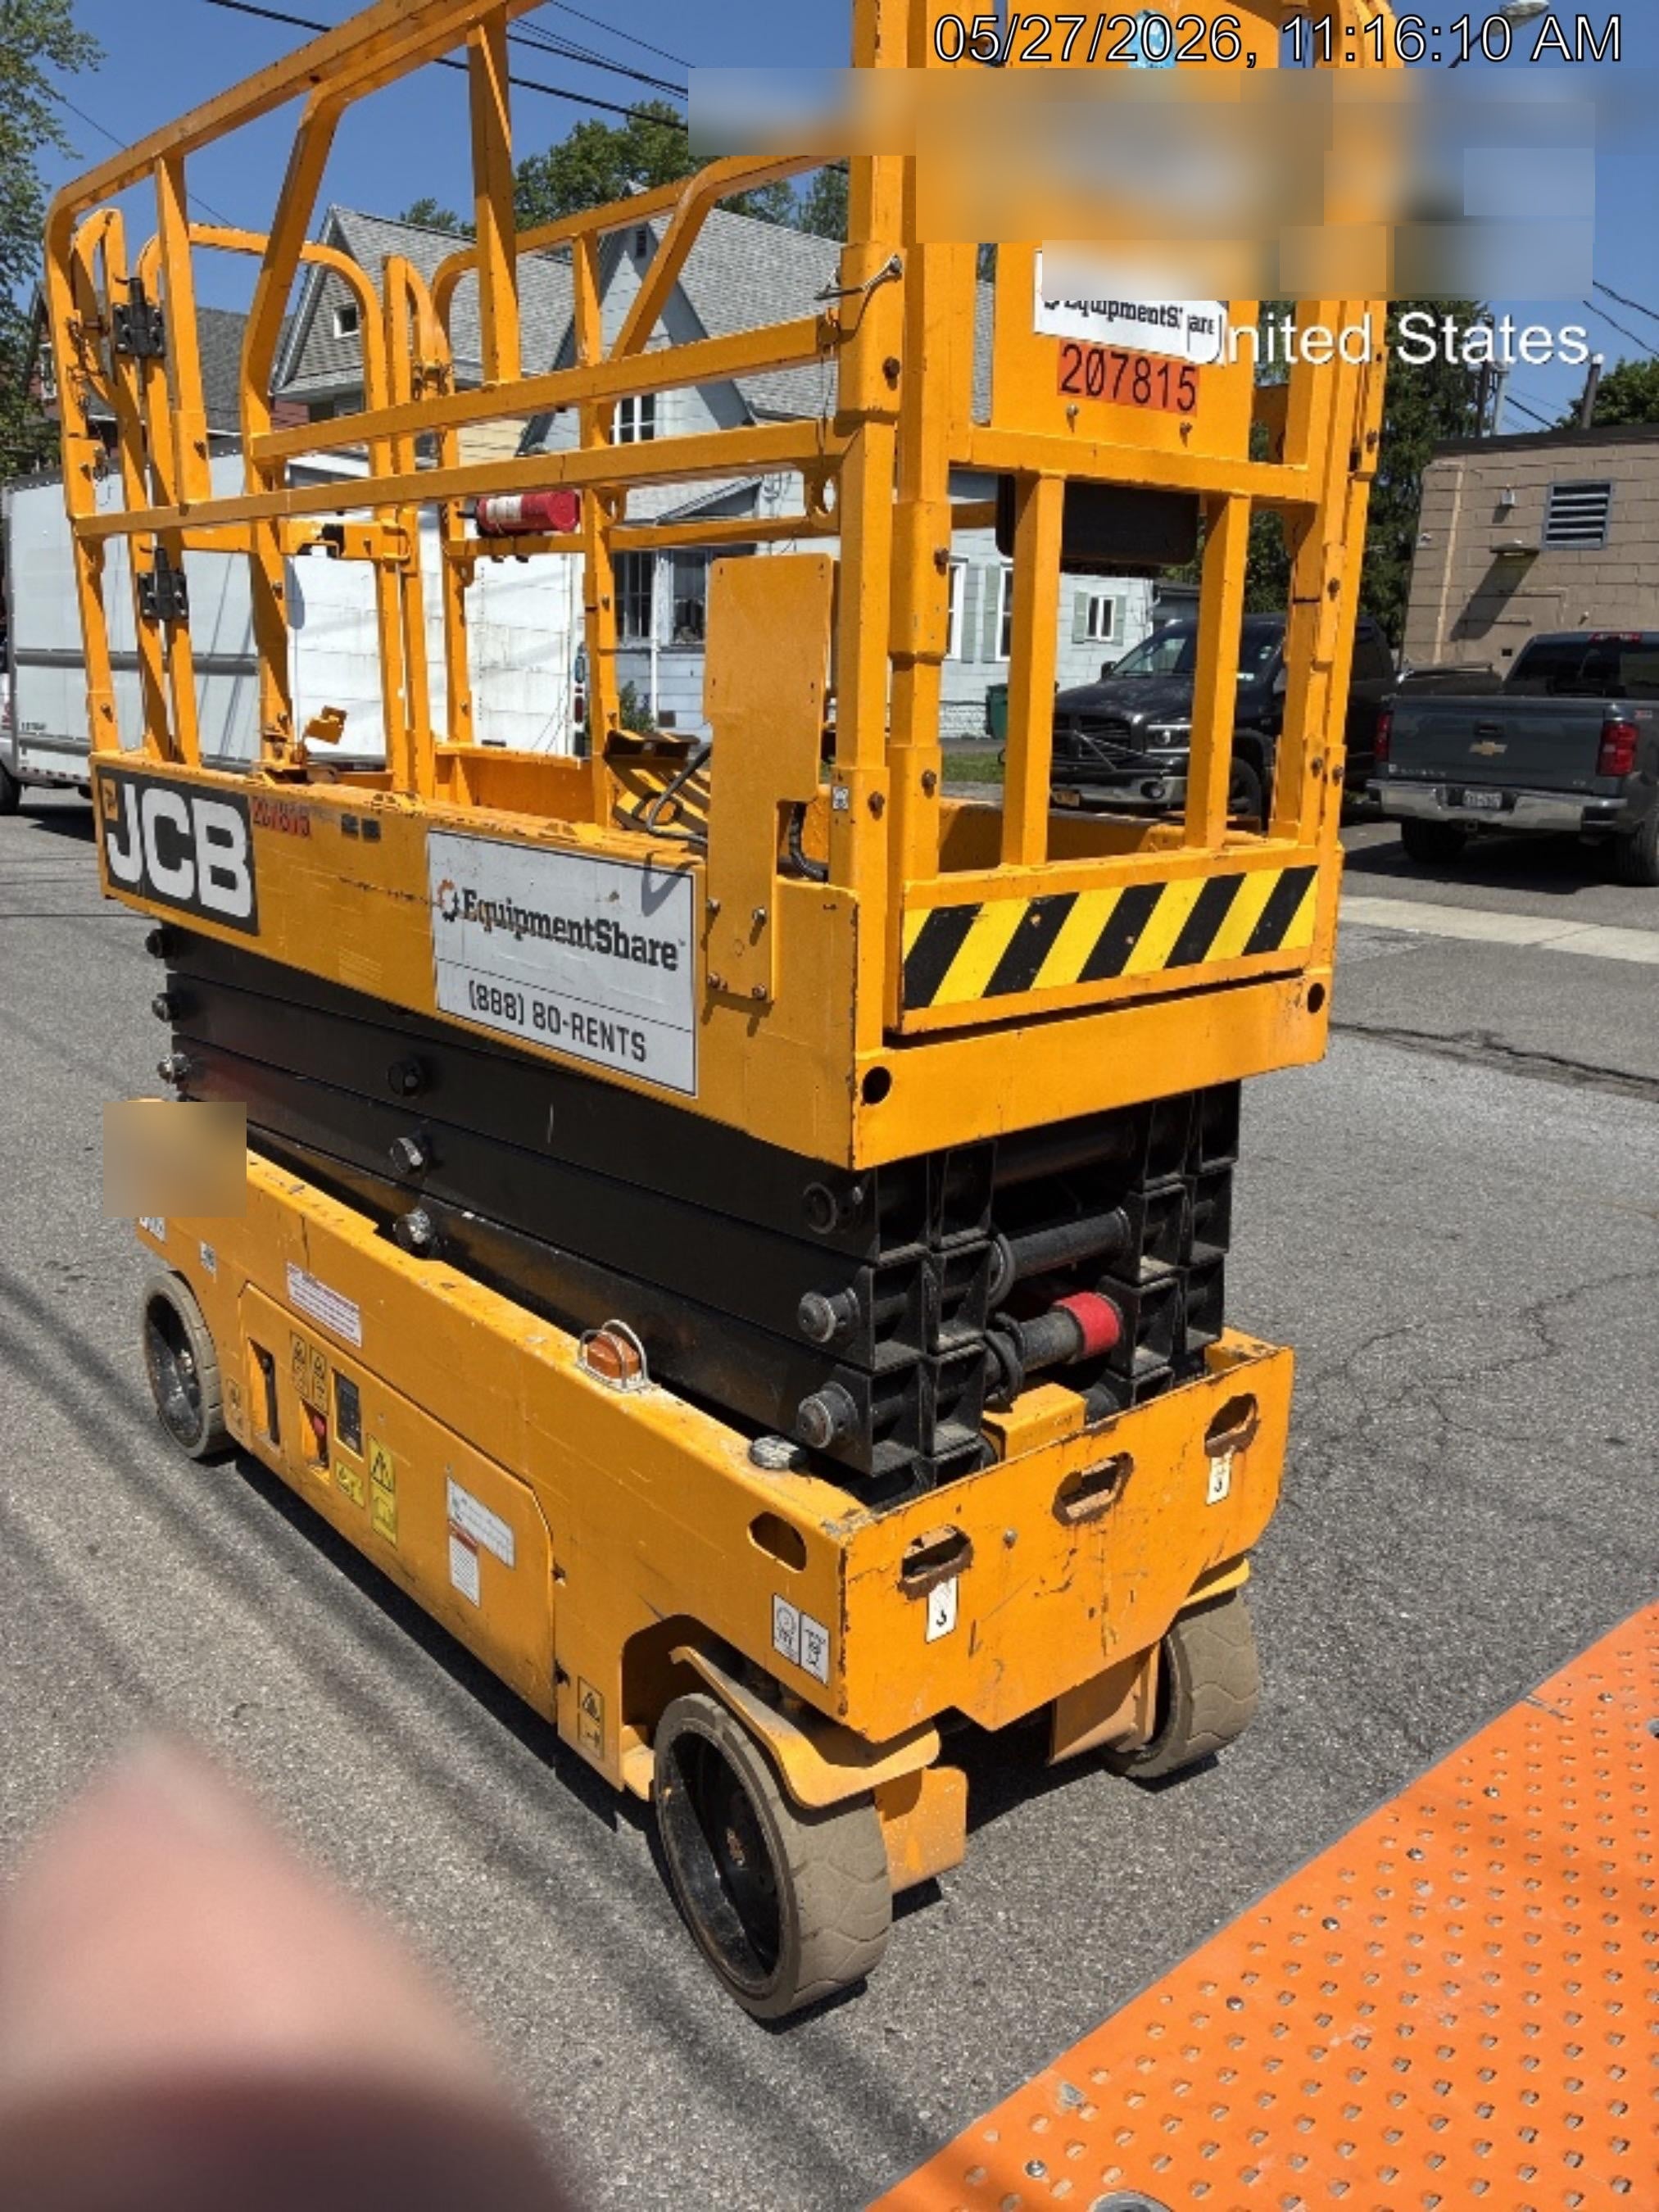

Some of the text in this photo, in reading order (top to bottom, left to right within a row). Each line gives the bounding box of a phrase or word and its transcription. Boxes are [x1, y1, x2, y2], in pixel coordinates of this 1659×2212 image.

[1061, 343, 1196, 412] 207815
[107, 782, 253, 918] JCB
[461, 887, 678, 972] EquipmentShare
[468, 979, 646, 1063] (888) 80-RENTS
